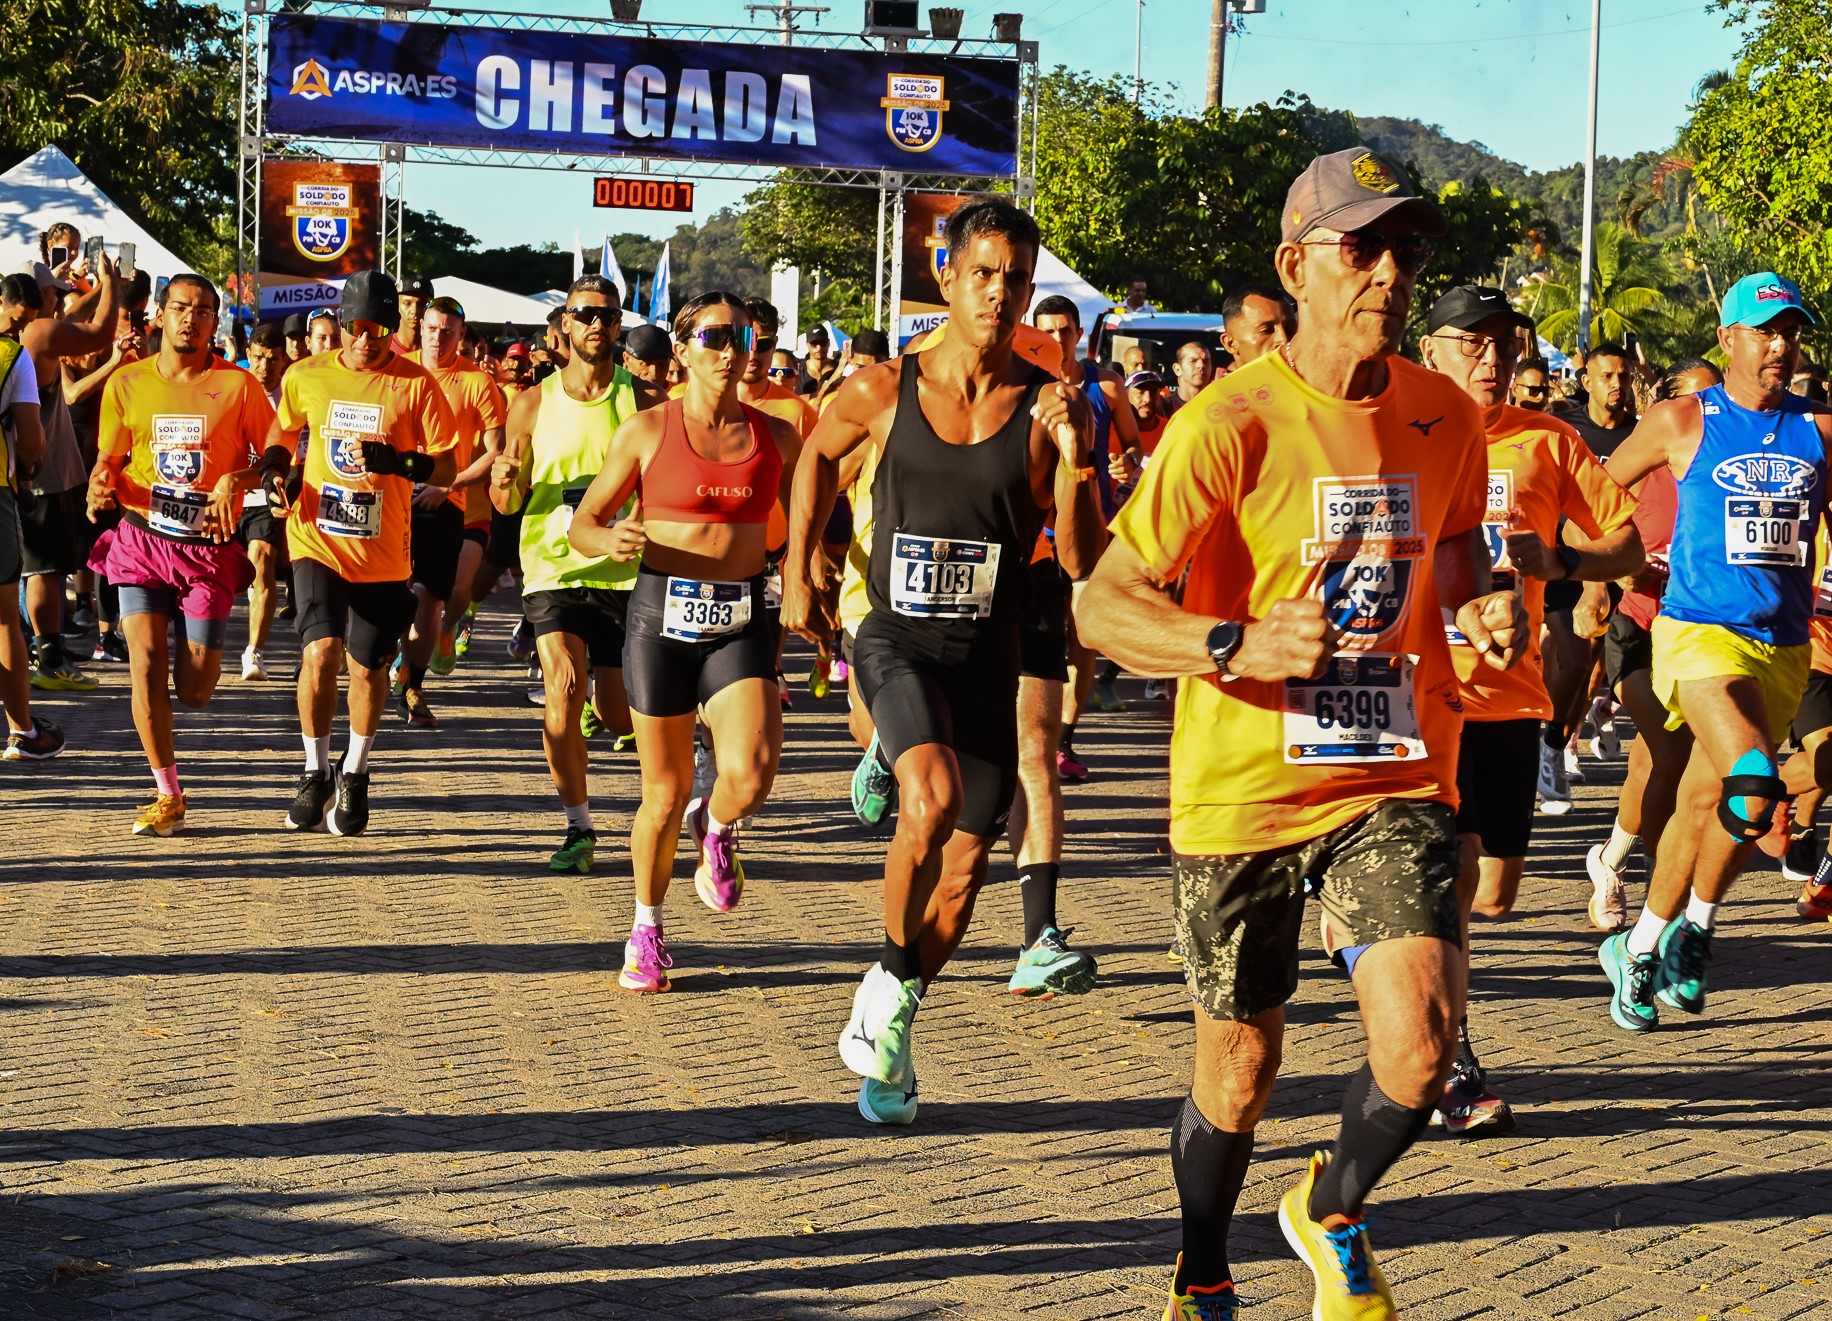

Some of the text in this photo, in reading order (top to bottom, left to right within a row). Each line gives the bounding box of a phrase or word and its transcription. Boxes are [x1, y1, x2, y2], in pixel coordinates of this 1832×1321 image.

[475, 53, 817, 146] CHEGADA
[906, 111, 924, 121] 10K
[288, 207, 319, 215] MISSÃO
[335, 208, 356, 216] 2025
[313, 220, 332, 229] 10K
[273, 283, 338, 304] MISSÃO
[911, 316, 950, 332] MISS
[333, 420, 375, 430] CONFIAUTO
[171, 453, 188, 462] 10K
[1746, 459, 1792, 482] NR
[696, 484, 753, 498] CAFUSO
[1344, 487, 1400, 499] CORRIDA DO
[161, 501, 200, 525] 6847
[327, 502, 367, 524] 4388
[1488, 512, 1514, 521] 2025
[1331, 519, 1411, 535] CONFIAUTO
[1745, 520, 1792, 545] 6100
[1393, 539, 1424, 555] 2025
[907, 563, 971, 593] 4103
[1353, 565, 1389, 583] 10K
[1383, 597, 1399, 608] CB
[683, 600, 733, 626] 3363
[1315, 689, 1391, 730] 6399
